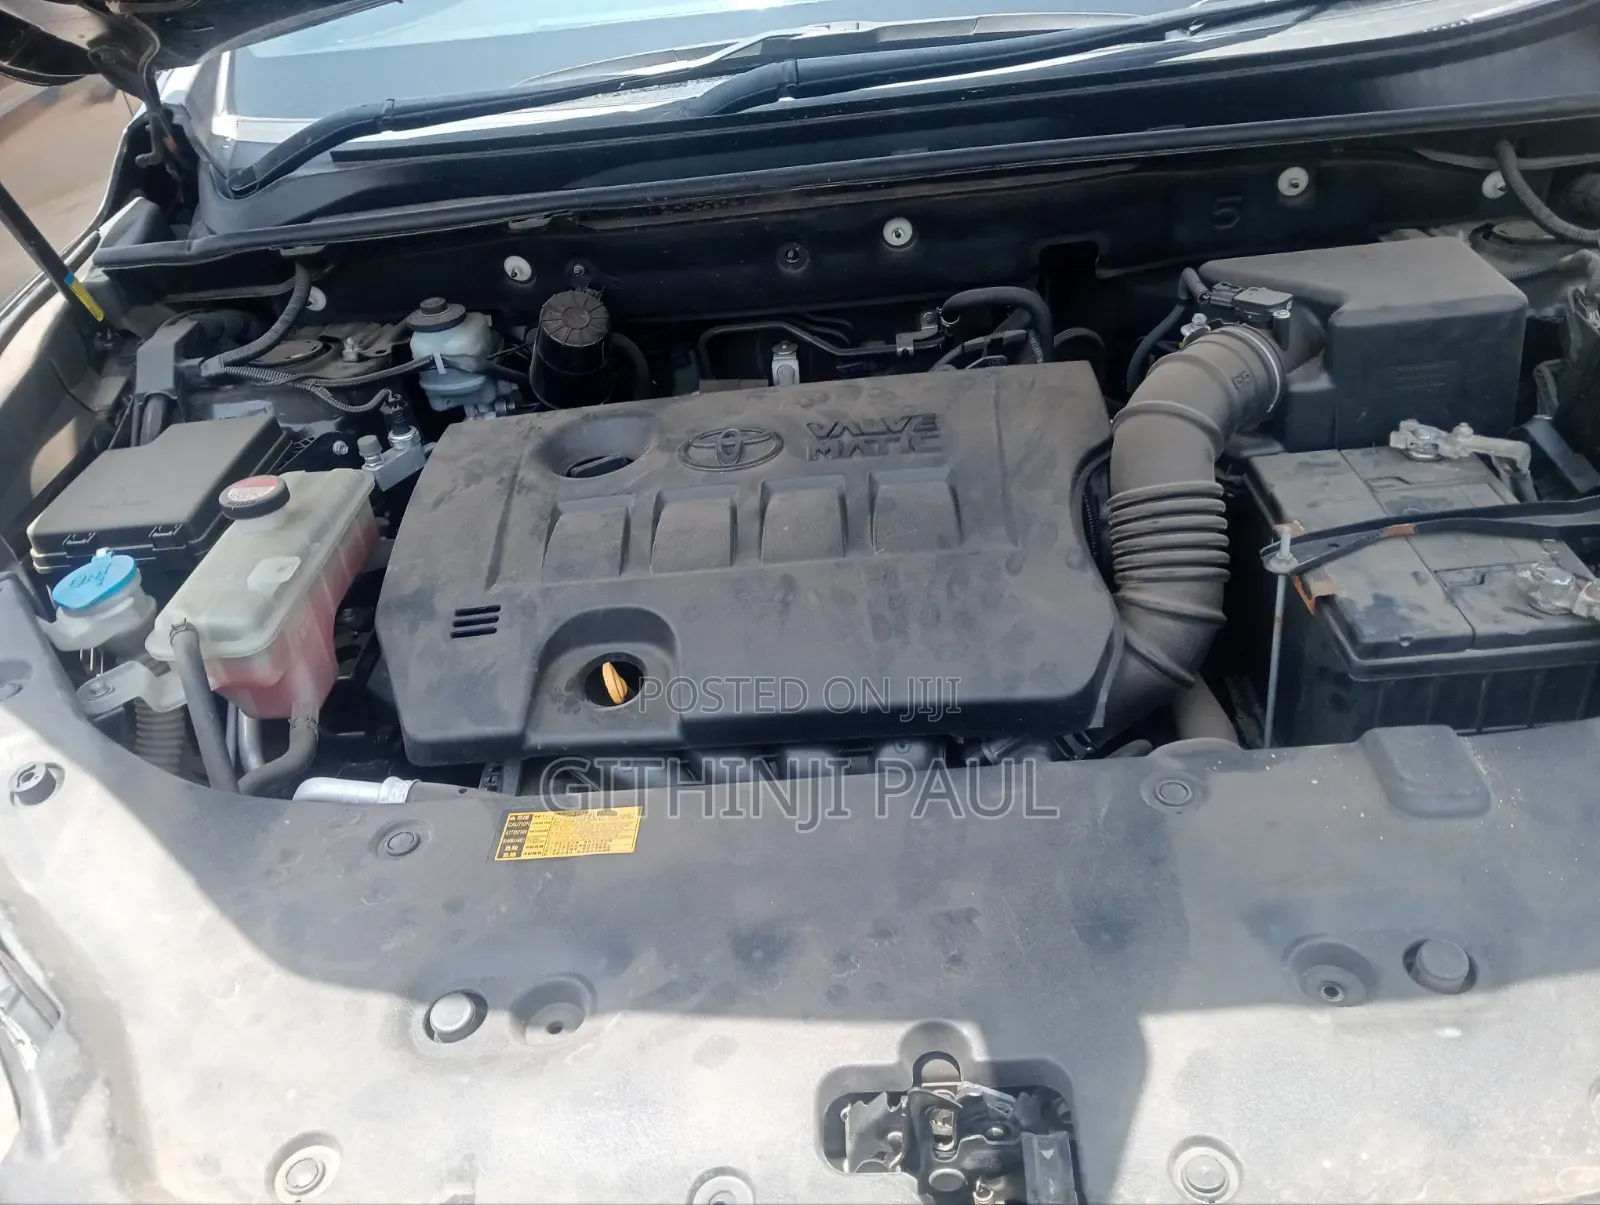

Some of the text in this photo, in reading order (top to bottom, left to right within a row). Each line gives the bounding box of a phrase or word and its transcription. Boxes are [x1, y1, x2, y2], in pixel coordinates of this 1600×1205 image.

[1212, 195, 1243, 230] 5
[805, 413, 939, 441] VALVE
[805, 434, 942, 462] MATIC
